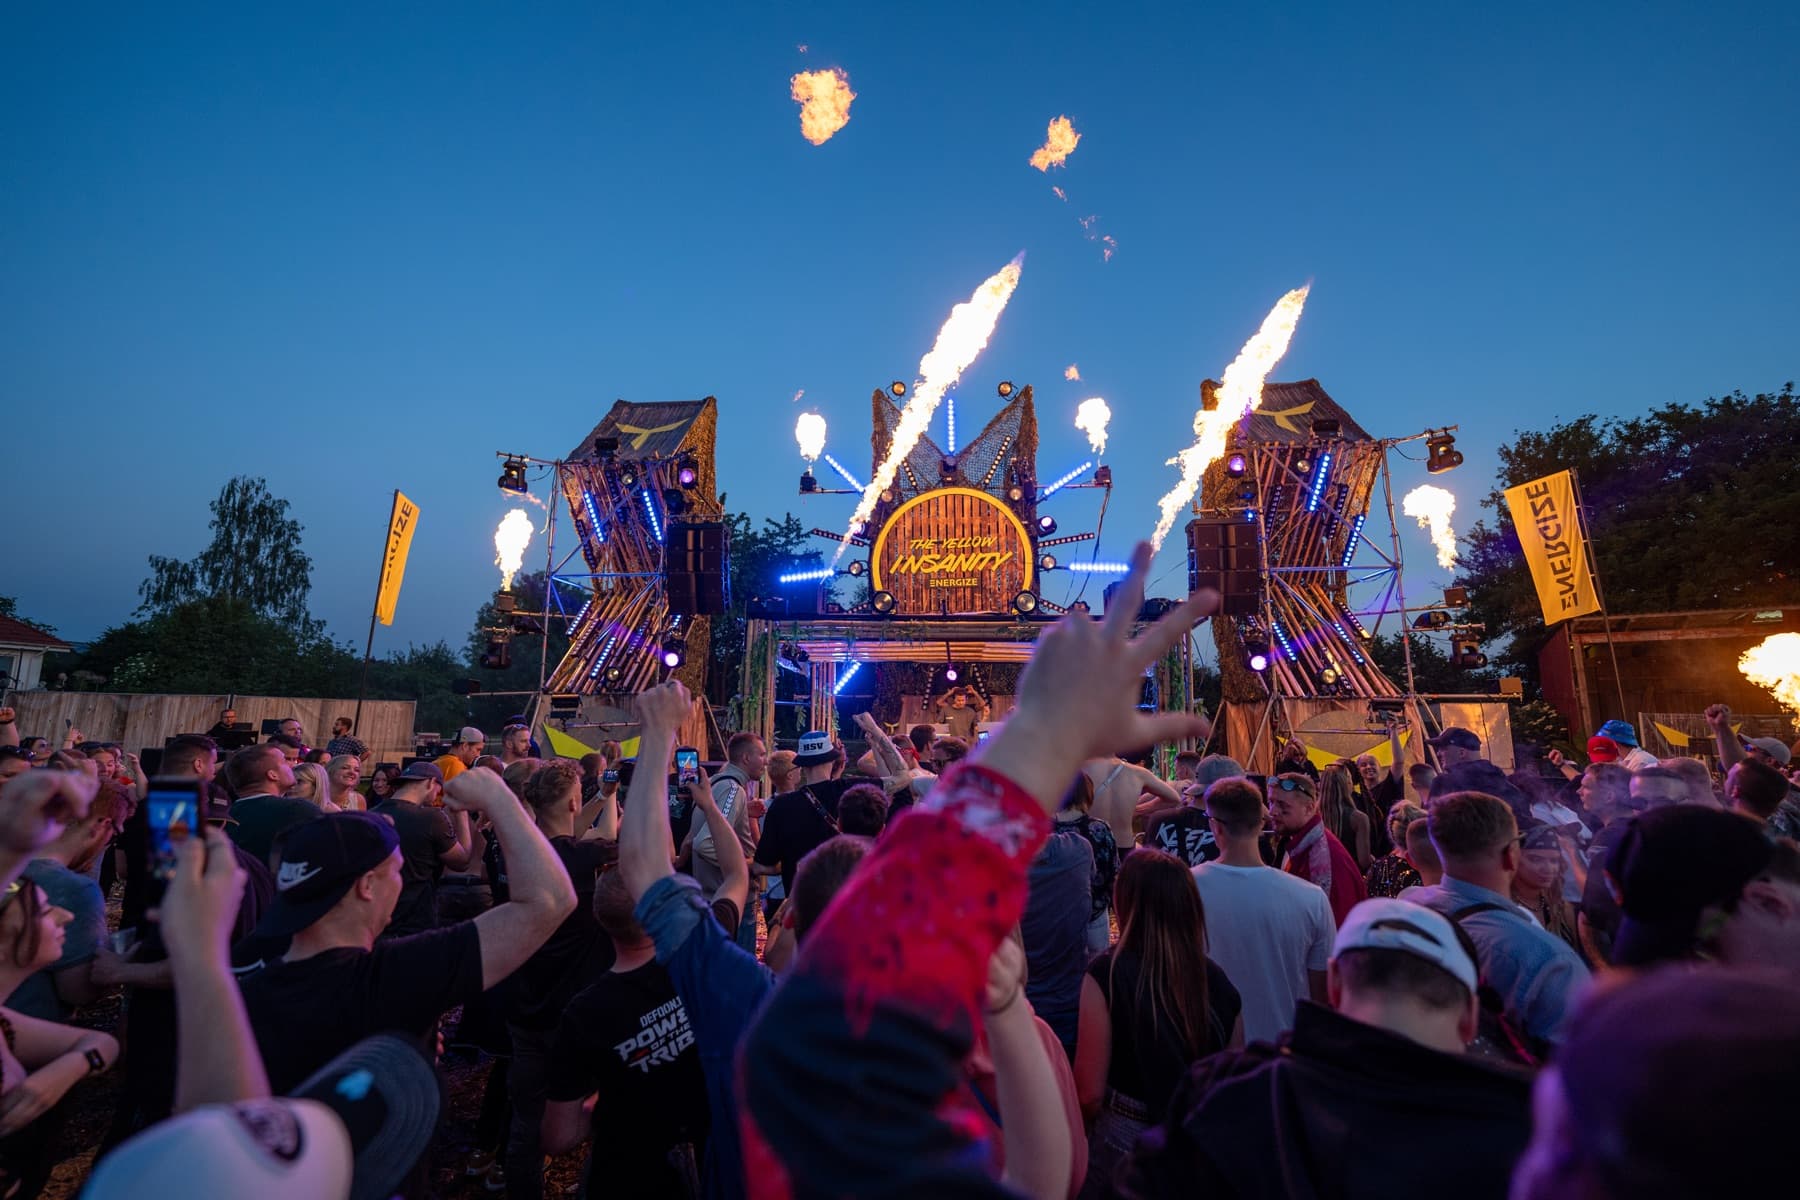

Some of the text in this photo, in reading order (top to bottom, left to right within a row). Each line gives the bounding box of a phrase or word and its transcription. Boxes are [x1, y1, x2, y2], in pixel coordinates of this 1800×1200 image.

[910, 535, 997, 550] THE YELLOW
[889, 551, 1013, 574] INSANITY
[930, 577, 978, 587] ENERGIZE
[613, 1006, 688, 1061] POWE
[650, 1022, 691, 1050] OF THE
[628, 1029, 696, 1073] TRIB
